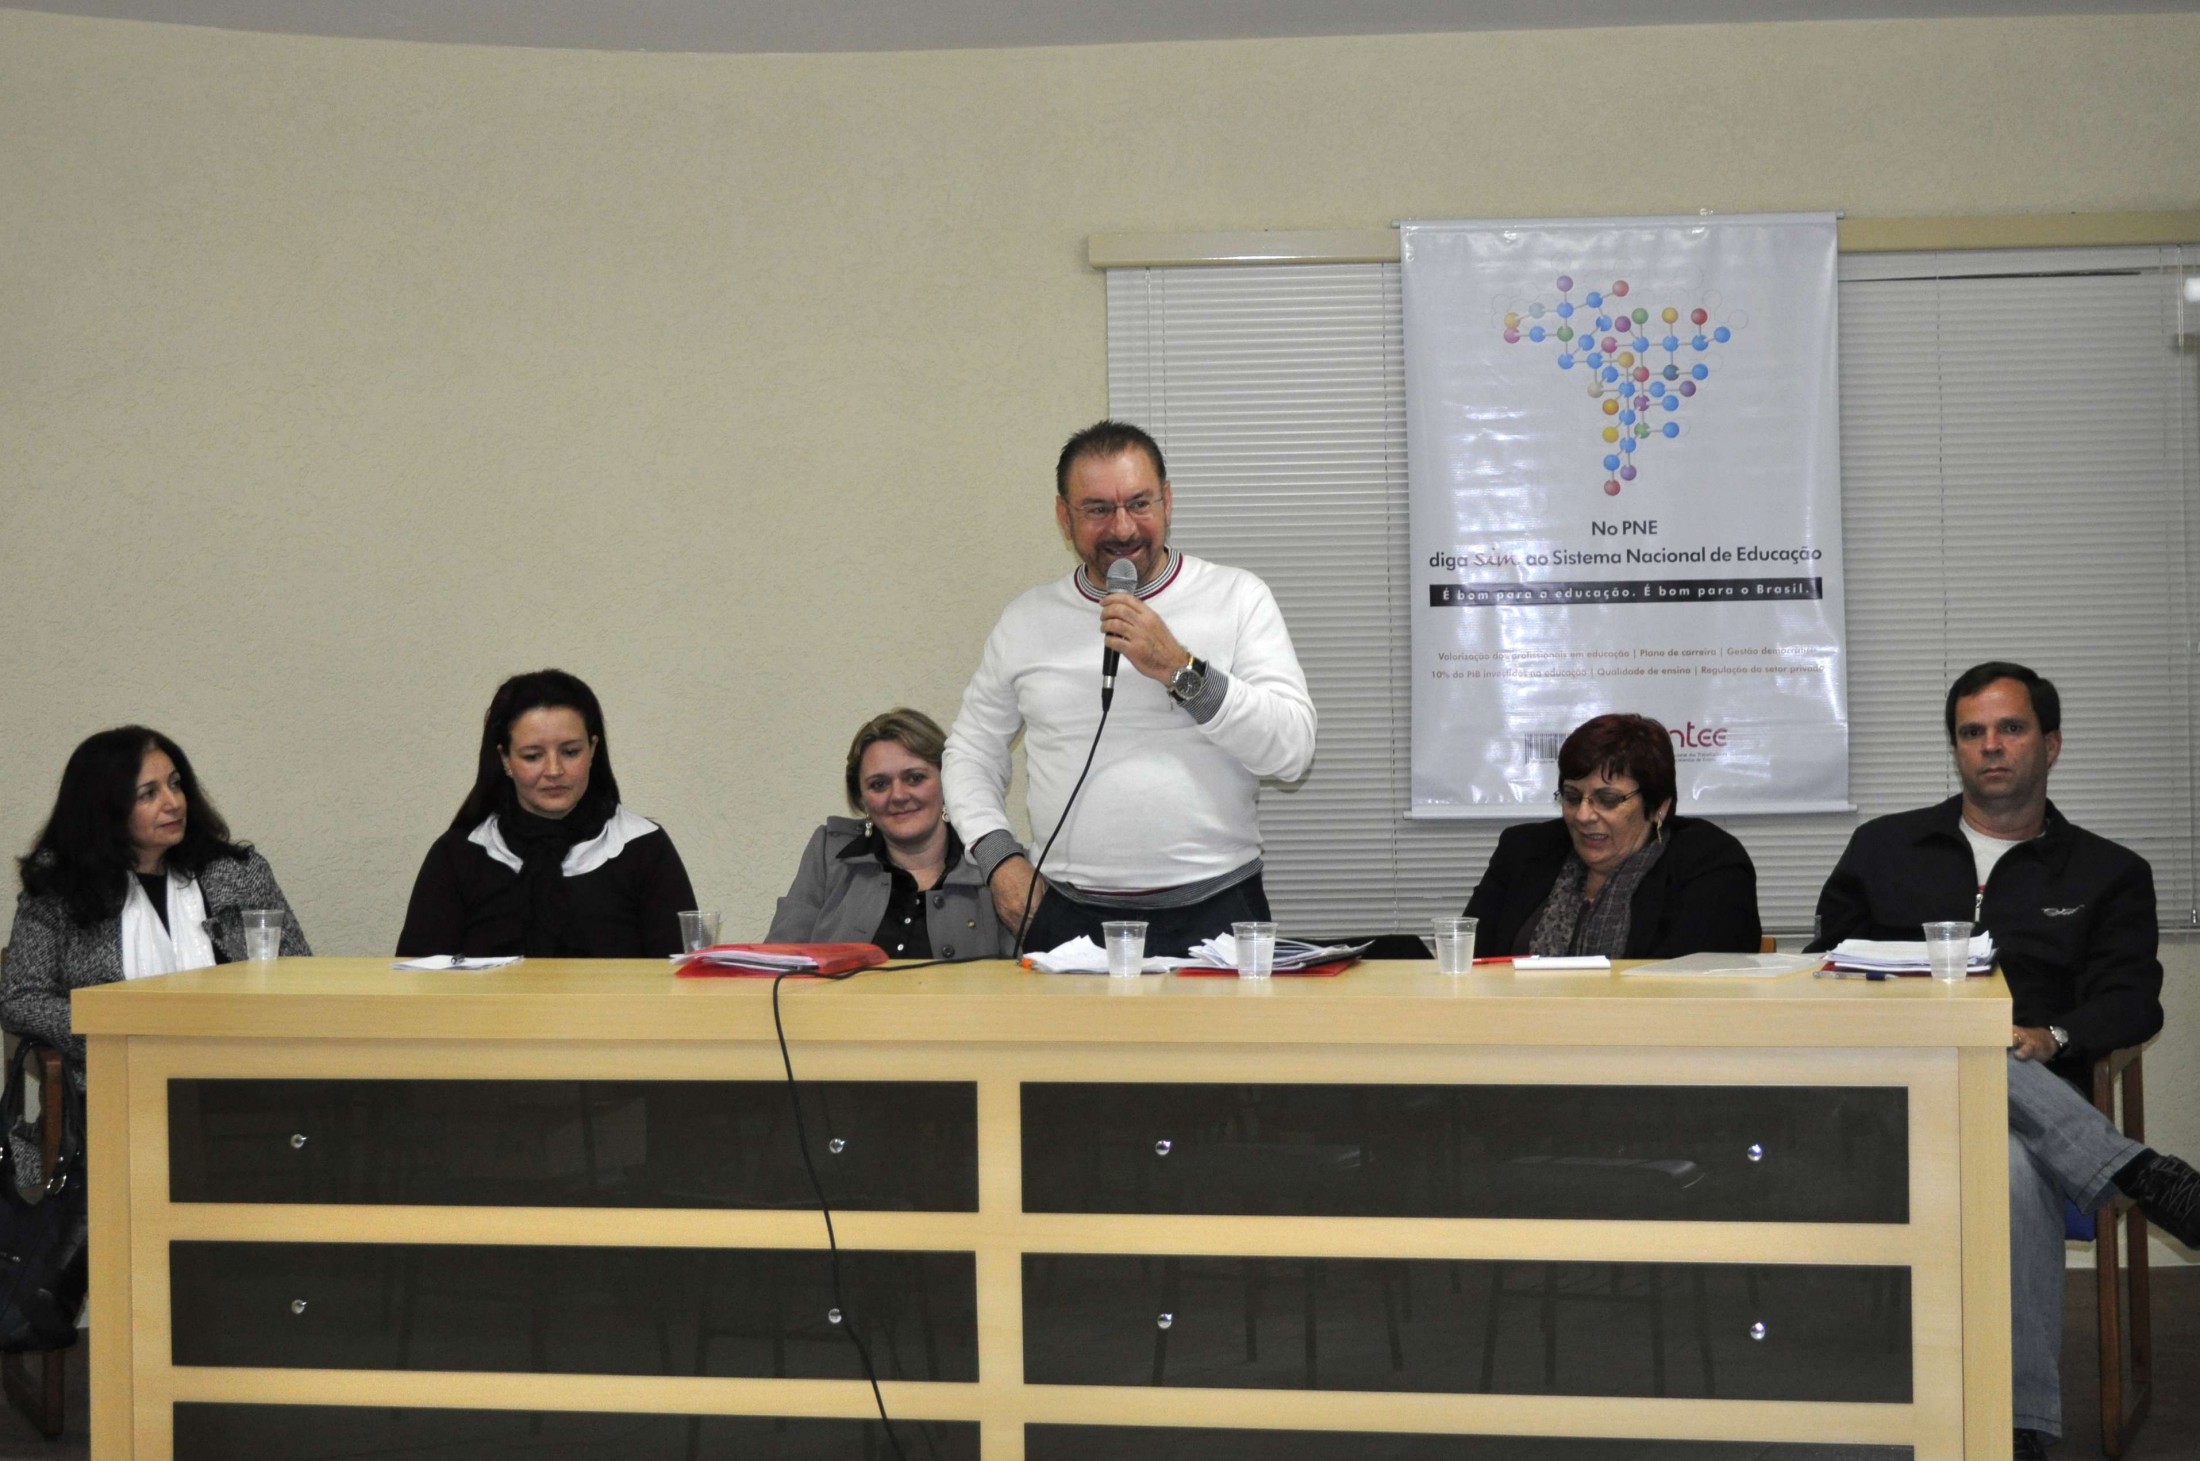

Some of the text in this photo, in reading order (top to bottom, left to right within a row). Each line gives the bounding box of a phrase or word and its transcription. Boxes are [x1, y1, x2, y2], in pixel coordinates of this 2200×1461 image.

[1592, 520, 1658, 536] No PNE
[1429, 551, 1468, 571] diga
[1526, 554, 1549, 567] ao
[1553, 549, 1621, 566] Sistema
[1626, 547, 1706, 564] Nacional
[1710, 547, 1732, 562] de
[1737, 546, 1822, 565] Educação
[1443, 583, 1810, 602] É bom para a educação. É bom para o Brasil.
[1438, 652, 1490, 662] Valorização
[1587, 650, 1630, 659] educação
[1640, 648, 1664, 657] Plano
[1668, 648, 1679, 657] de
[1681, 648, 1717, 656] carreira
[1727, 647, 1759, 656] Gestão
[1452, 670, 1464, 679] do
[1467, 670, 1481, 678] PIB
[1544, 668, 1587, 678] educação
[1597, 667, 1645, 677] Qualidade
[1662, 665, 1691, 674] ensino
[1701, 665, 1748, 675] Regulação
[1750, 665, 1762, 673] do
[1765, 665, 1788, 673] setor
[1790, 663, 1825, 674] privado
